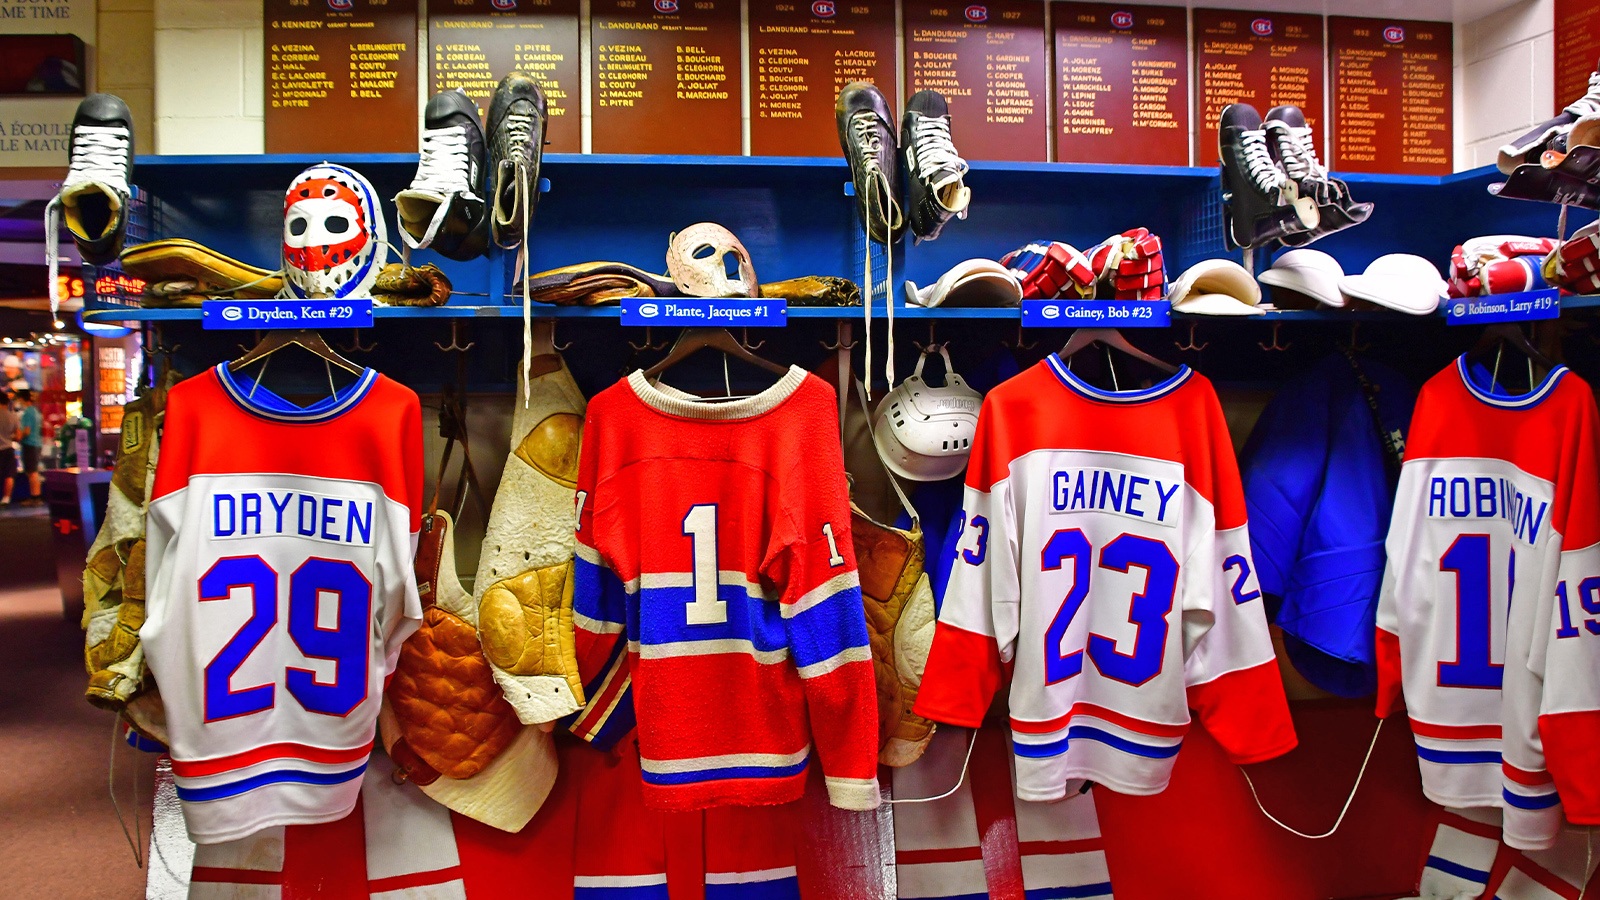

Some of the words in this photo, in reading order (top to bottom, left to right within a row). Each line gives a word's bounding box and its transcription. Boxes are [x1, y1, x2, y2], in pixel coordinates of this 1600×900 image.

[0, 7, 26, 18] ME
[29, 7, 70, 18] TIME
[248, 307, 297, 322] Dryden,
[301, 307, 325, 319] Ken
[329, 307, 352, 319] #29
[665, 305, 705, 318] Plante,
[708, 305, 751, 320] Jacques
[754, 306, 768, 317] #1
[1065, 306, 1104, 320] Gainey,
[1108, 306, 1129, 318] Bob
[1132, 307, 1152, 318] #23
[1469, 303, 1507, 315] Robinson,
[1510, 300, 1532, 313] Larry
[1534, 297, 1551, 309] #19
[213, 492, 372, 544] DRYDEN
[575, 490, 587, 532] 1
[1053, 470, 1180, 522] GAINEY
[1429, 477, 1548, 545] ROBINON
[682, 503, 727, 626] 1
[822, 522, 844, 568] 1
[1041, 528, 1180, 688] 23
[1437, 534, 1515, 690] 1
[1555, 576, 1600, 640] 19
[197, 554, 372, 724] 29
